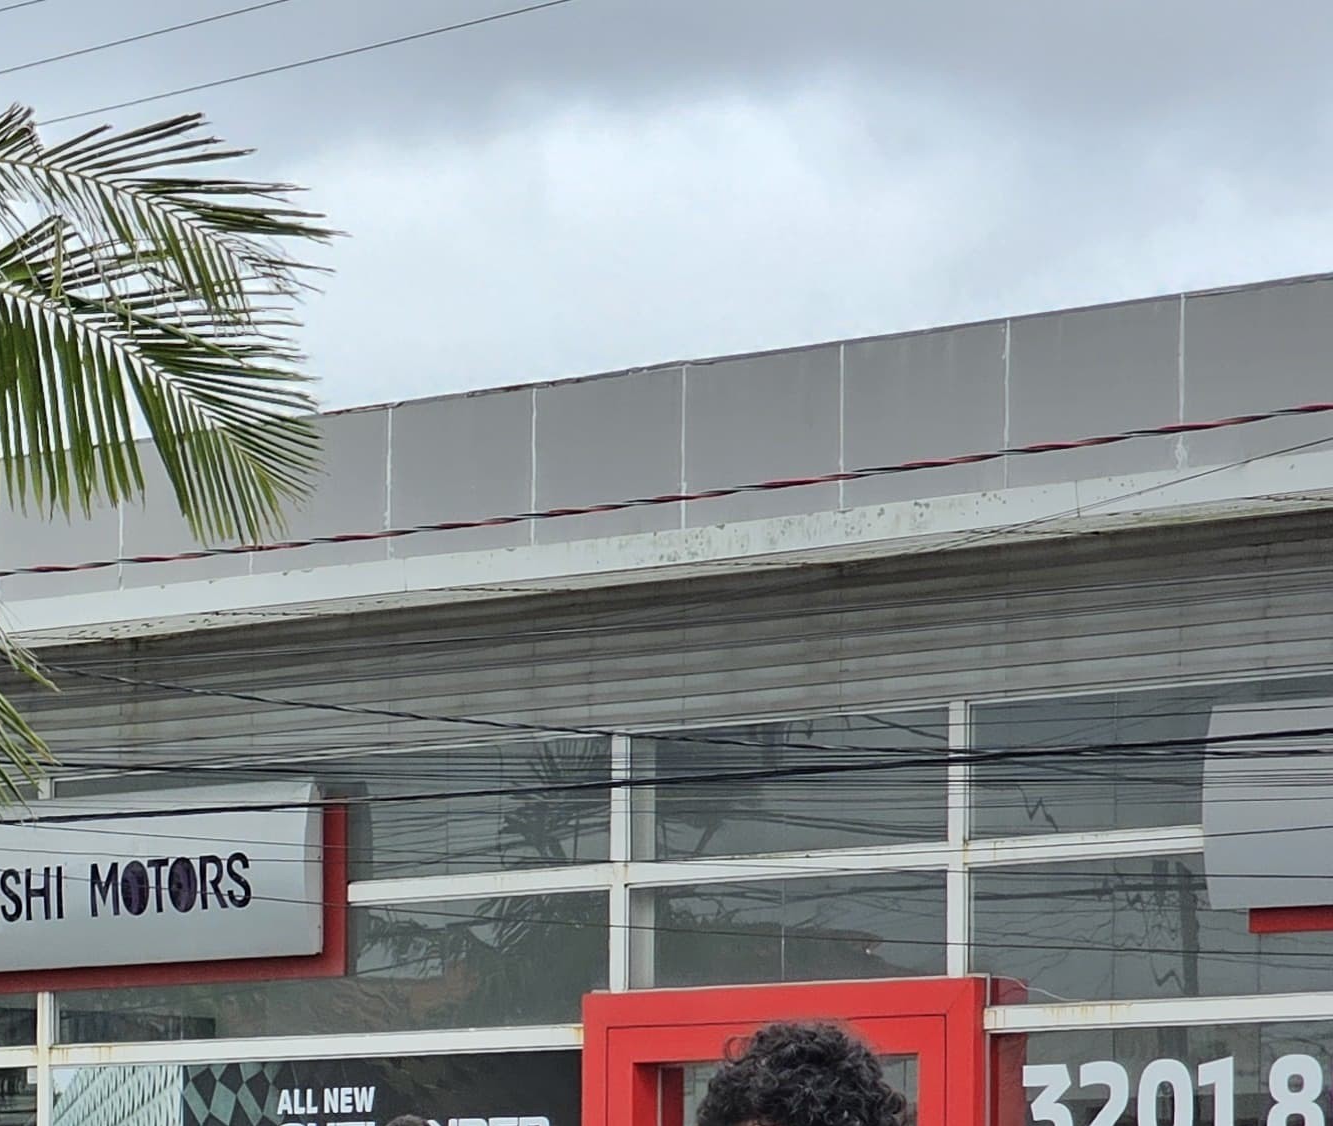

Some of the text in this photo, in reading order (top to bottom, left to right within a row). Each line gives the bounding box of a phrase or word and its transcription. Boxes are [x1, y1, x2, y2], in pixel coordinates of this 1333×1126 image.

[90, 852, 253, 917] MOTORS
[277, 1086, 375, 1115] ALL NEW
